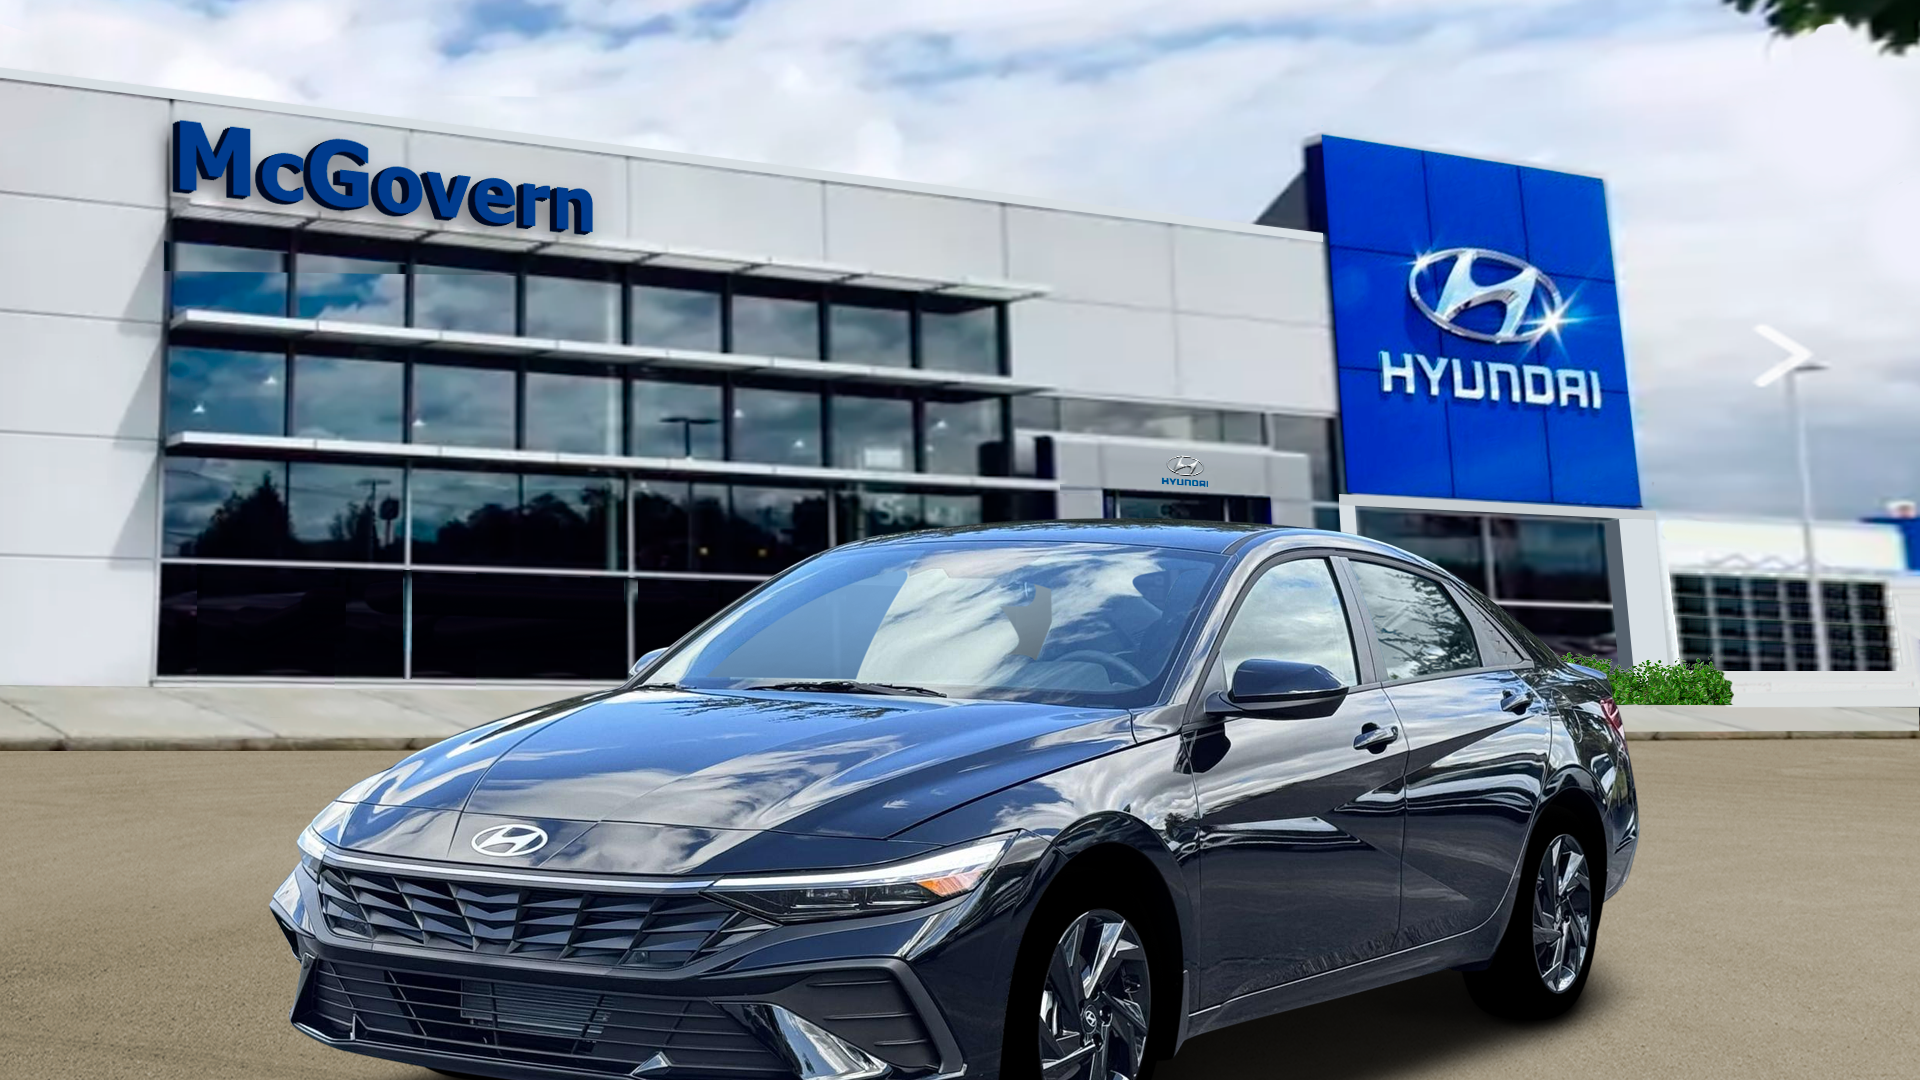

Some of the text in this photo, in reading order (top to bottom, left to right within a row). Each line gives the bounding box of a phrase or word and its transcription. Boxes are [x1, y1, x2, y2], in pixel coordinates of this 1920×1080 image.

[172, 119, 594, 236] McGovern
[1378, 350, 1602, 410] HYUNDAI
[1161, 477, 1209, 488] HYUNDAI
